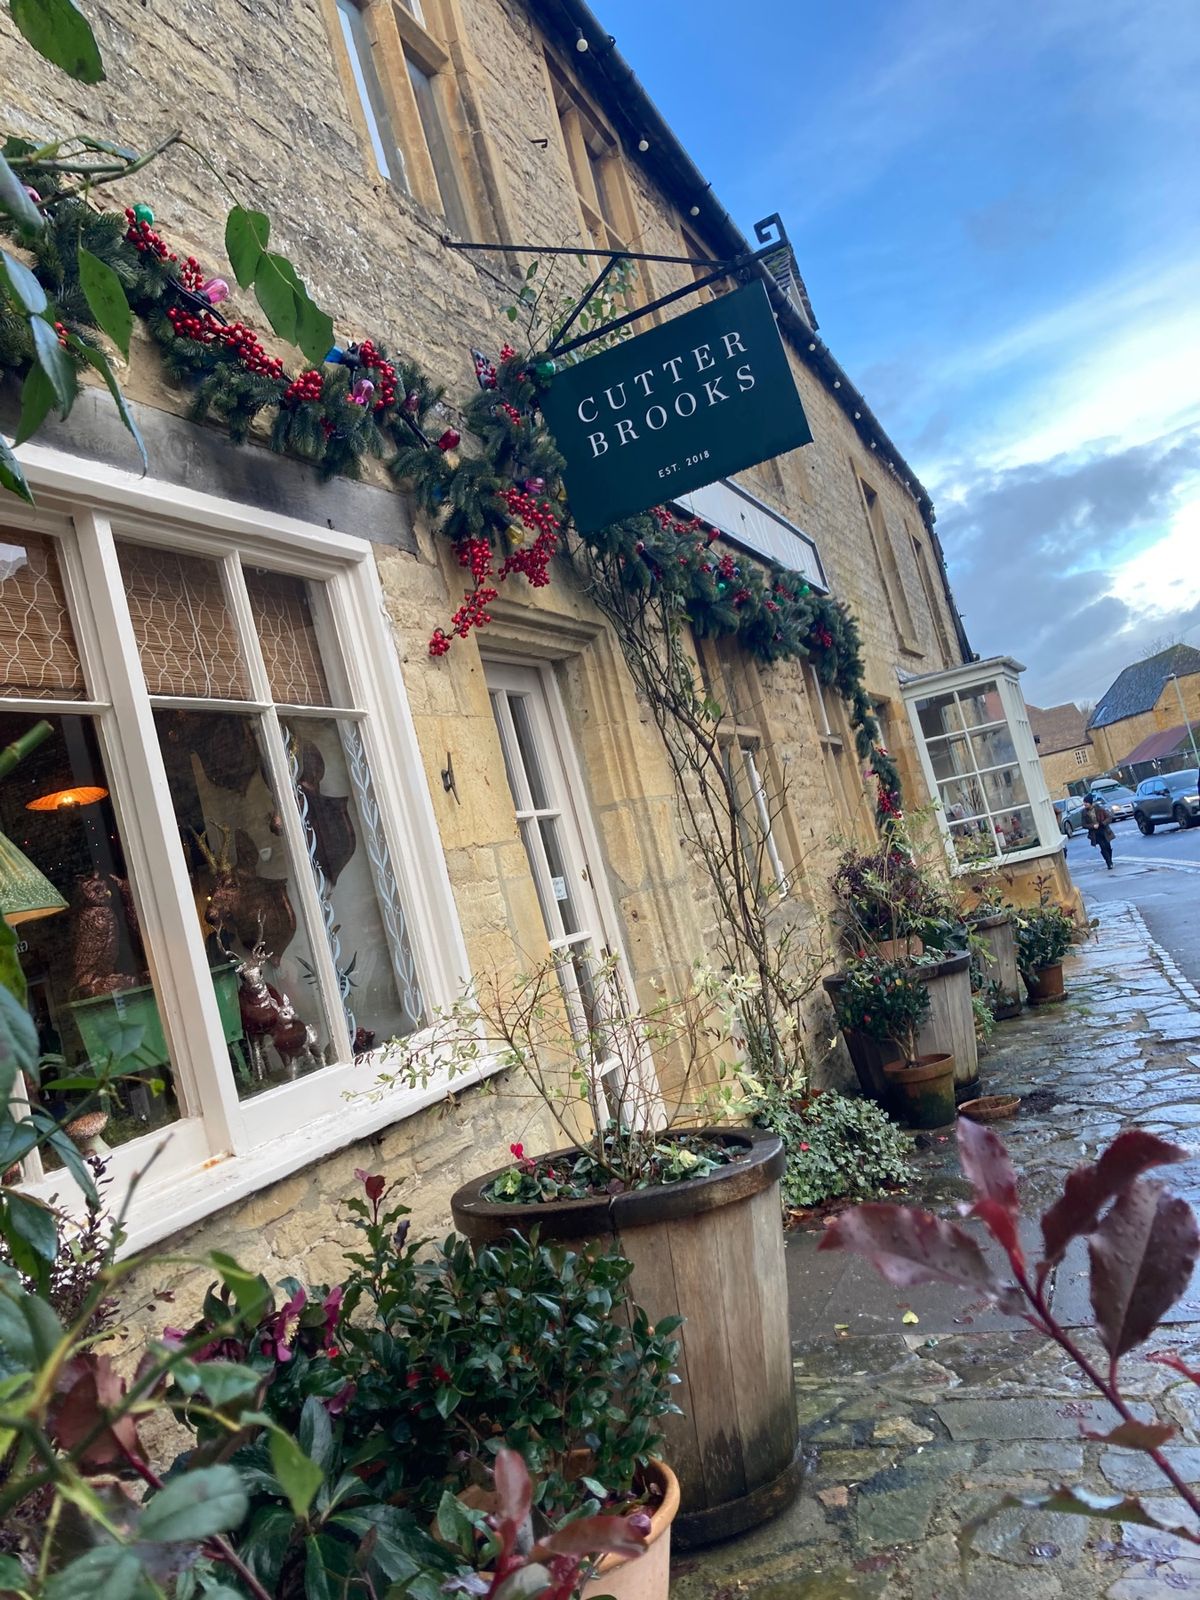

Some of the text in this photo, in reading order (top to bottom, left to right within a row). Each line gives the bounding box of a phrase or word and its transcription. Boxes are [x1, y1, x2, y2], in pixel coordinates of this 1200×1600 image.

[576, 331, 748, 423] CUTTER
[586, 363, 755, 458] BROOKS
[658, 450, 710, 478] EST. 2018
